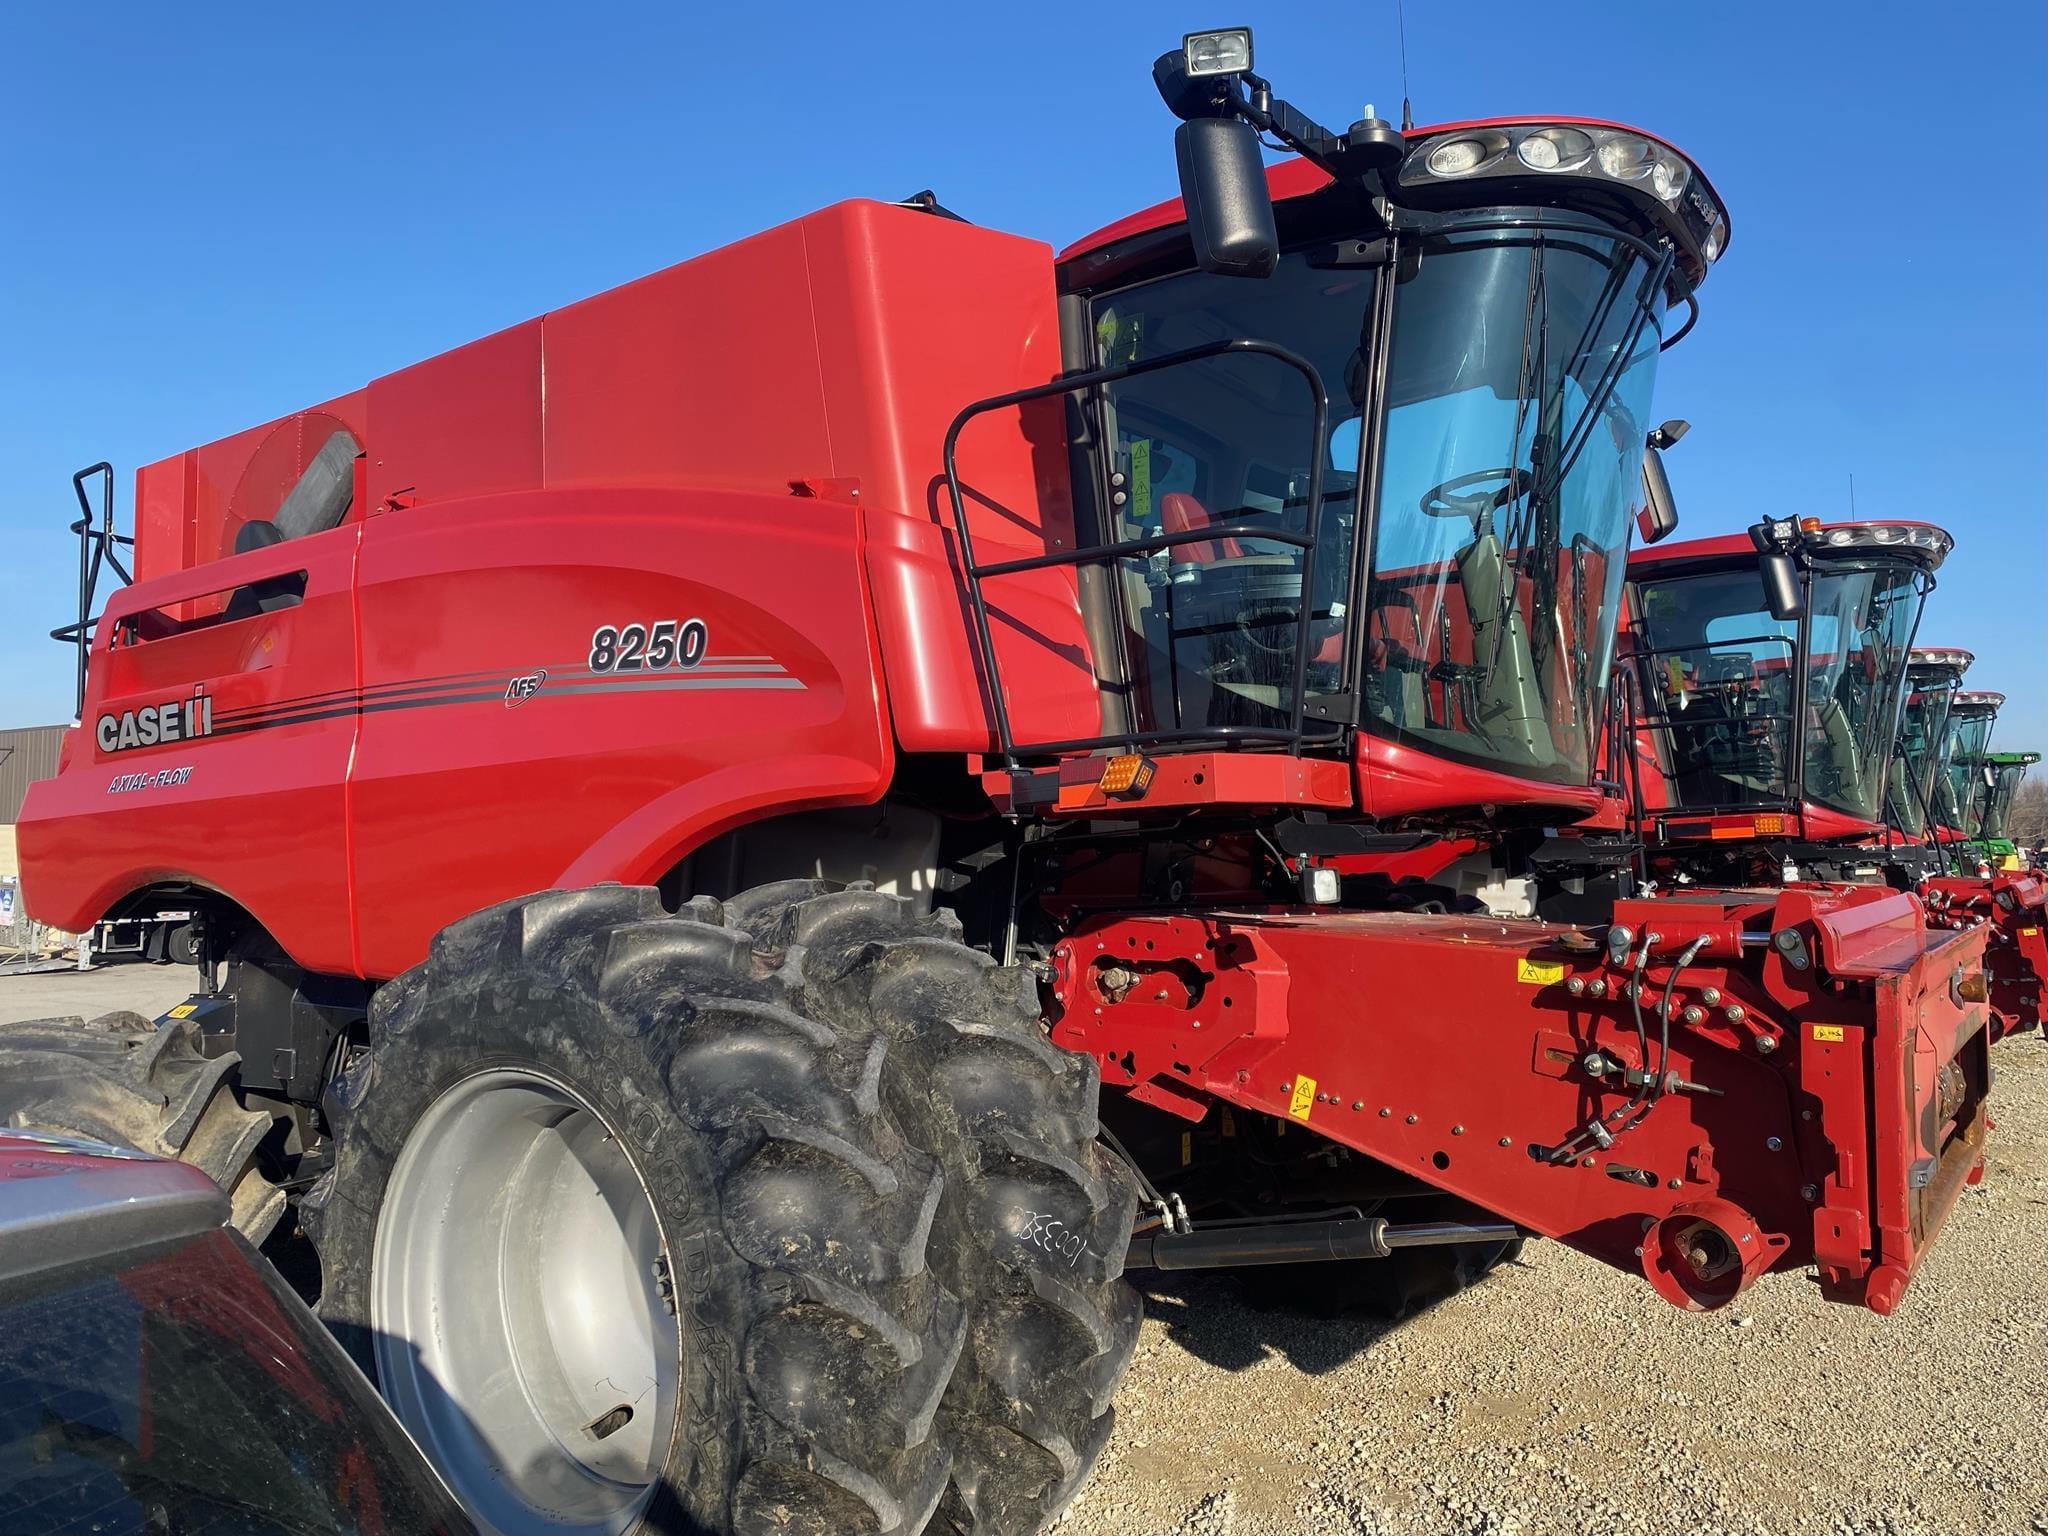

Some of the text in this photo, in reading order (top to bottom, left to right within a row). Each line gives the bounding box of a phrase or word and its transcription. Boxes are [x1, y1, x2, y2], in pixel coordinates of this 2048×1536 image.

[589, 617, 707, 673] 8250
[504, 676, 538, 699] AFS
[96, 701, 181, 752] CASE
[107, 766, 194, 794] AXIAL-FLOW
